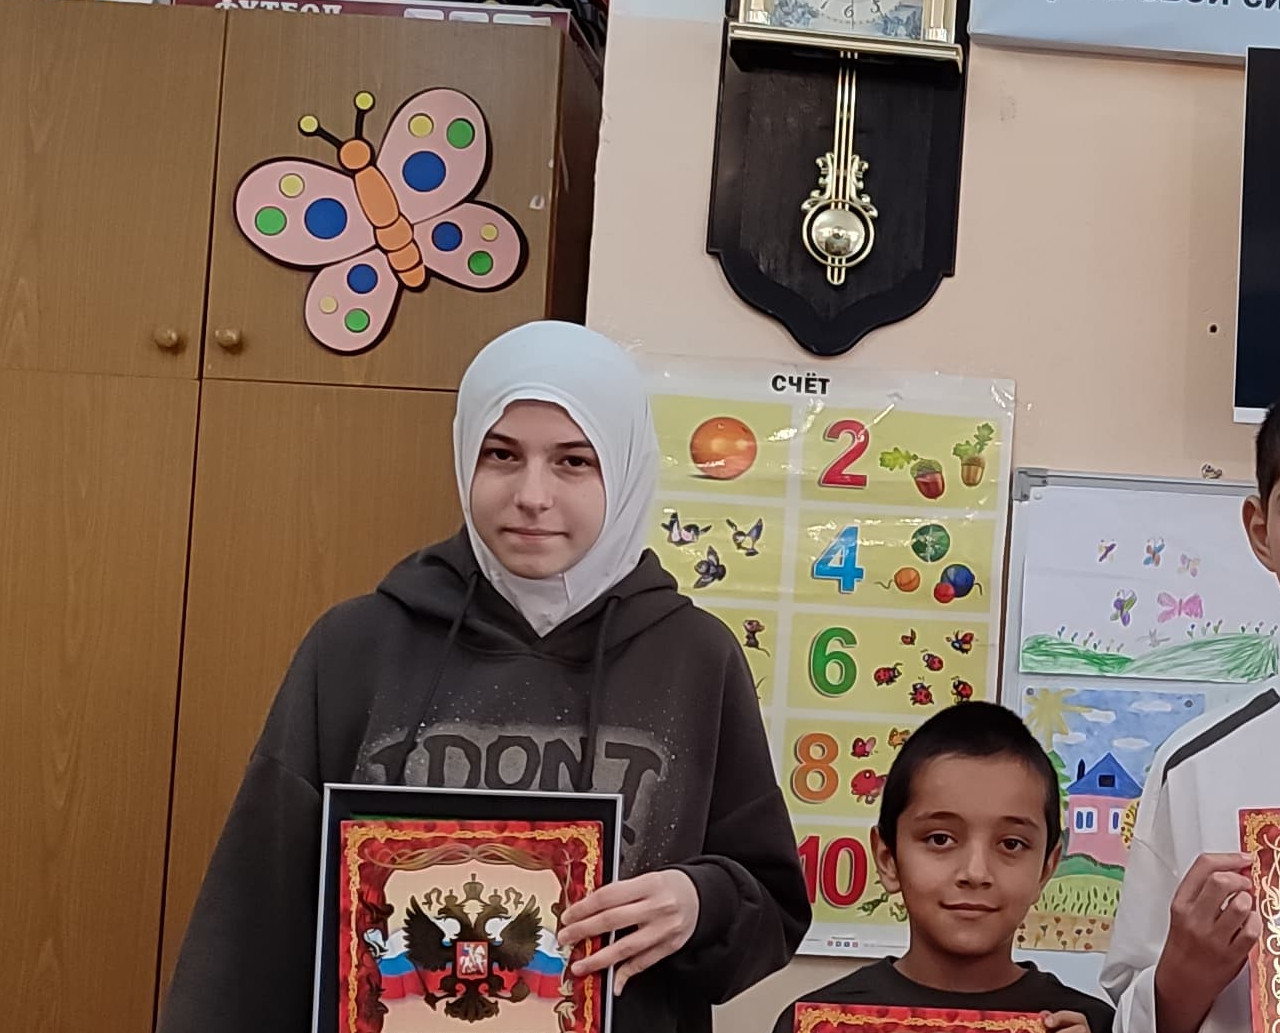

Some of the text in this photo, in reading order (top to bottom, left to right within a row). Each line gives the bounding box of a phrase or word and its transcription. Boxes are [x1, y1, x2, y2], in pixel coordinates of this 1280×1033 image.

[844, 7, 855, 18] 6
[771, 372, 831, 395] СЧЁТ
[818, 419, 870, 490] 2
[811, 524, 865, 594] 4
[808, 626, 858, 697] 6
[791, 732, 839, 804] 8
[798, 835, 868, 908] 10
